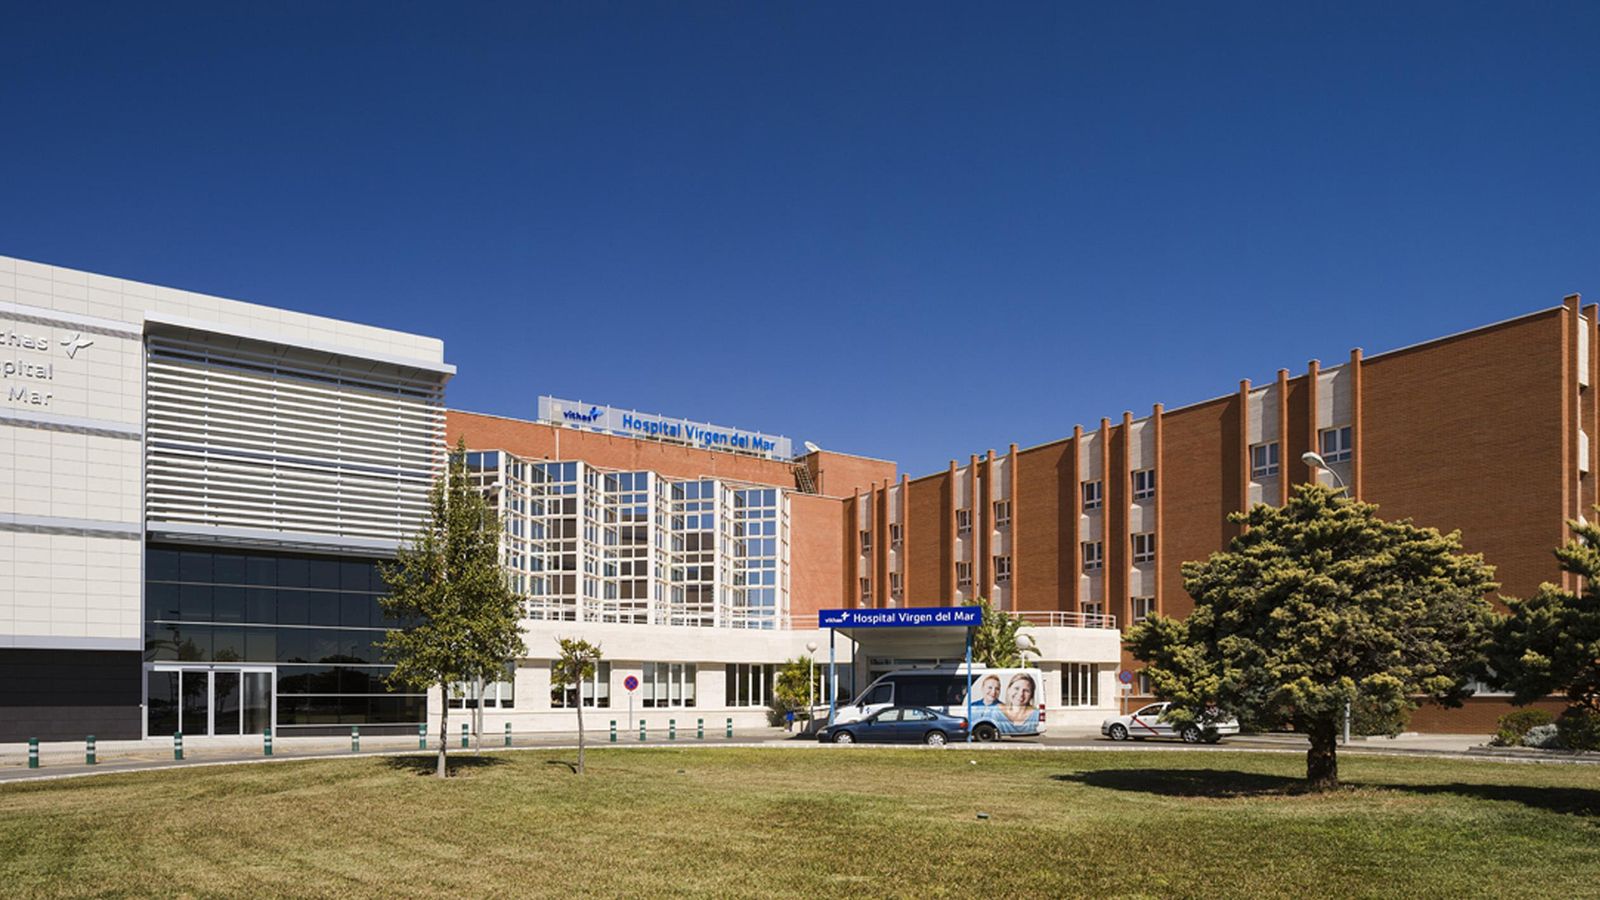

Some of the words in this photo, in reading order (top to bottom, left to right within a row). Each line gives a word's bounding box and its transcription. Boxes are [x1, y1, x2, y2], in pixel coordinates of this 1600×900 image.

[0, 360, 53, 380] pital
[8, 386, 53, 407] Mar
[563, 410, 592, 423] vithas
[622, 414, 682, 438] Hospital
[685, 425, 728, 445] Virgen
[731, 433, 749, 449] del
[752, 437, 777, 452] Mar
[853, 612, 896, 625] Hospital
[898, 612, 932, 625] Virgen
[935, 611, 951, 622] del
[954, 611, 975, 621] Mar
